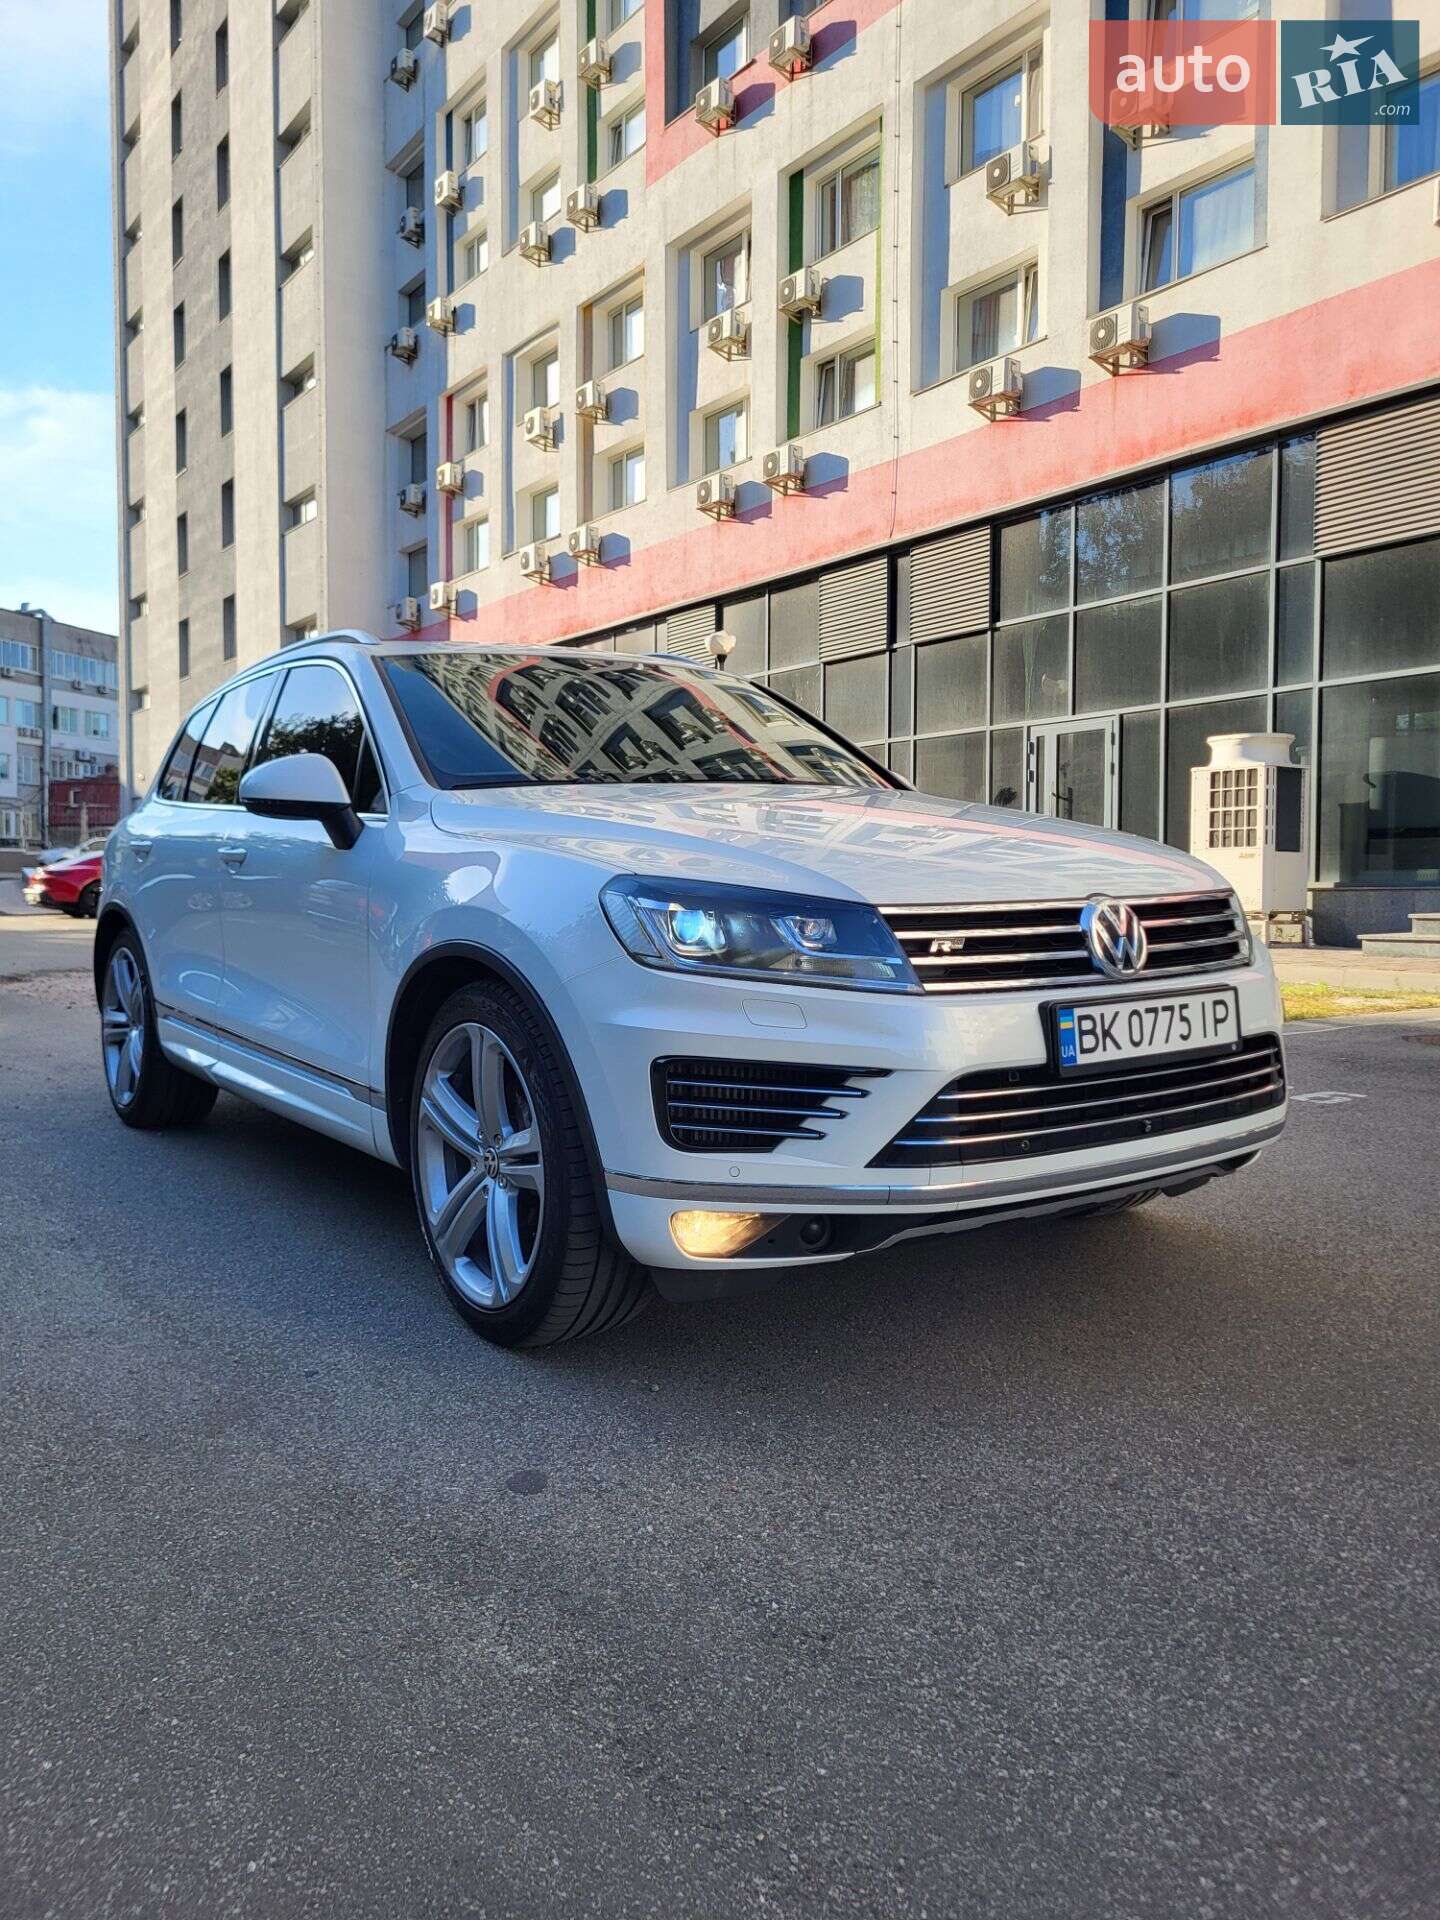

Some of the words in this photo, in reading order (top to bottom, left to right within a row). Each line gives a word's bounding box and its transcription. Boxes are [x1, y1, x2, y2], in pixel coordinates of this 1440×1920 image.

[1077, 1010, 1122, 1055] BK
[1128, 1003, 1192, 1048] 0775
[1201, 999, 1229, 1038] IP
[1061, 1046, 1076, 1058] UA
